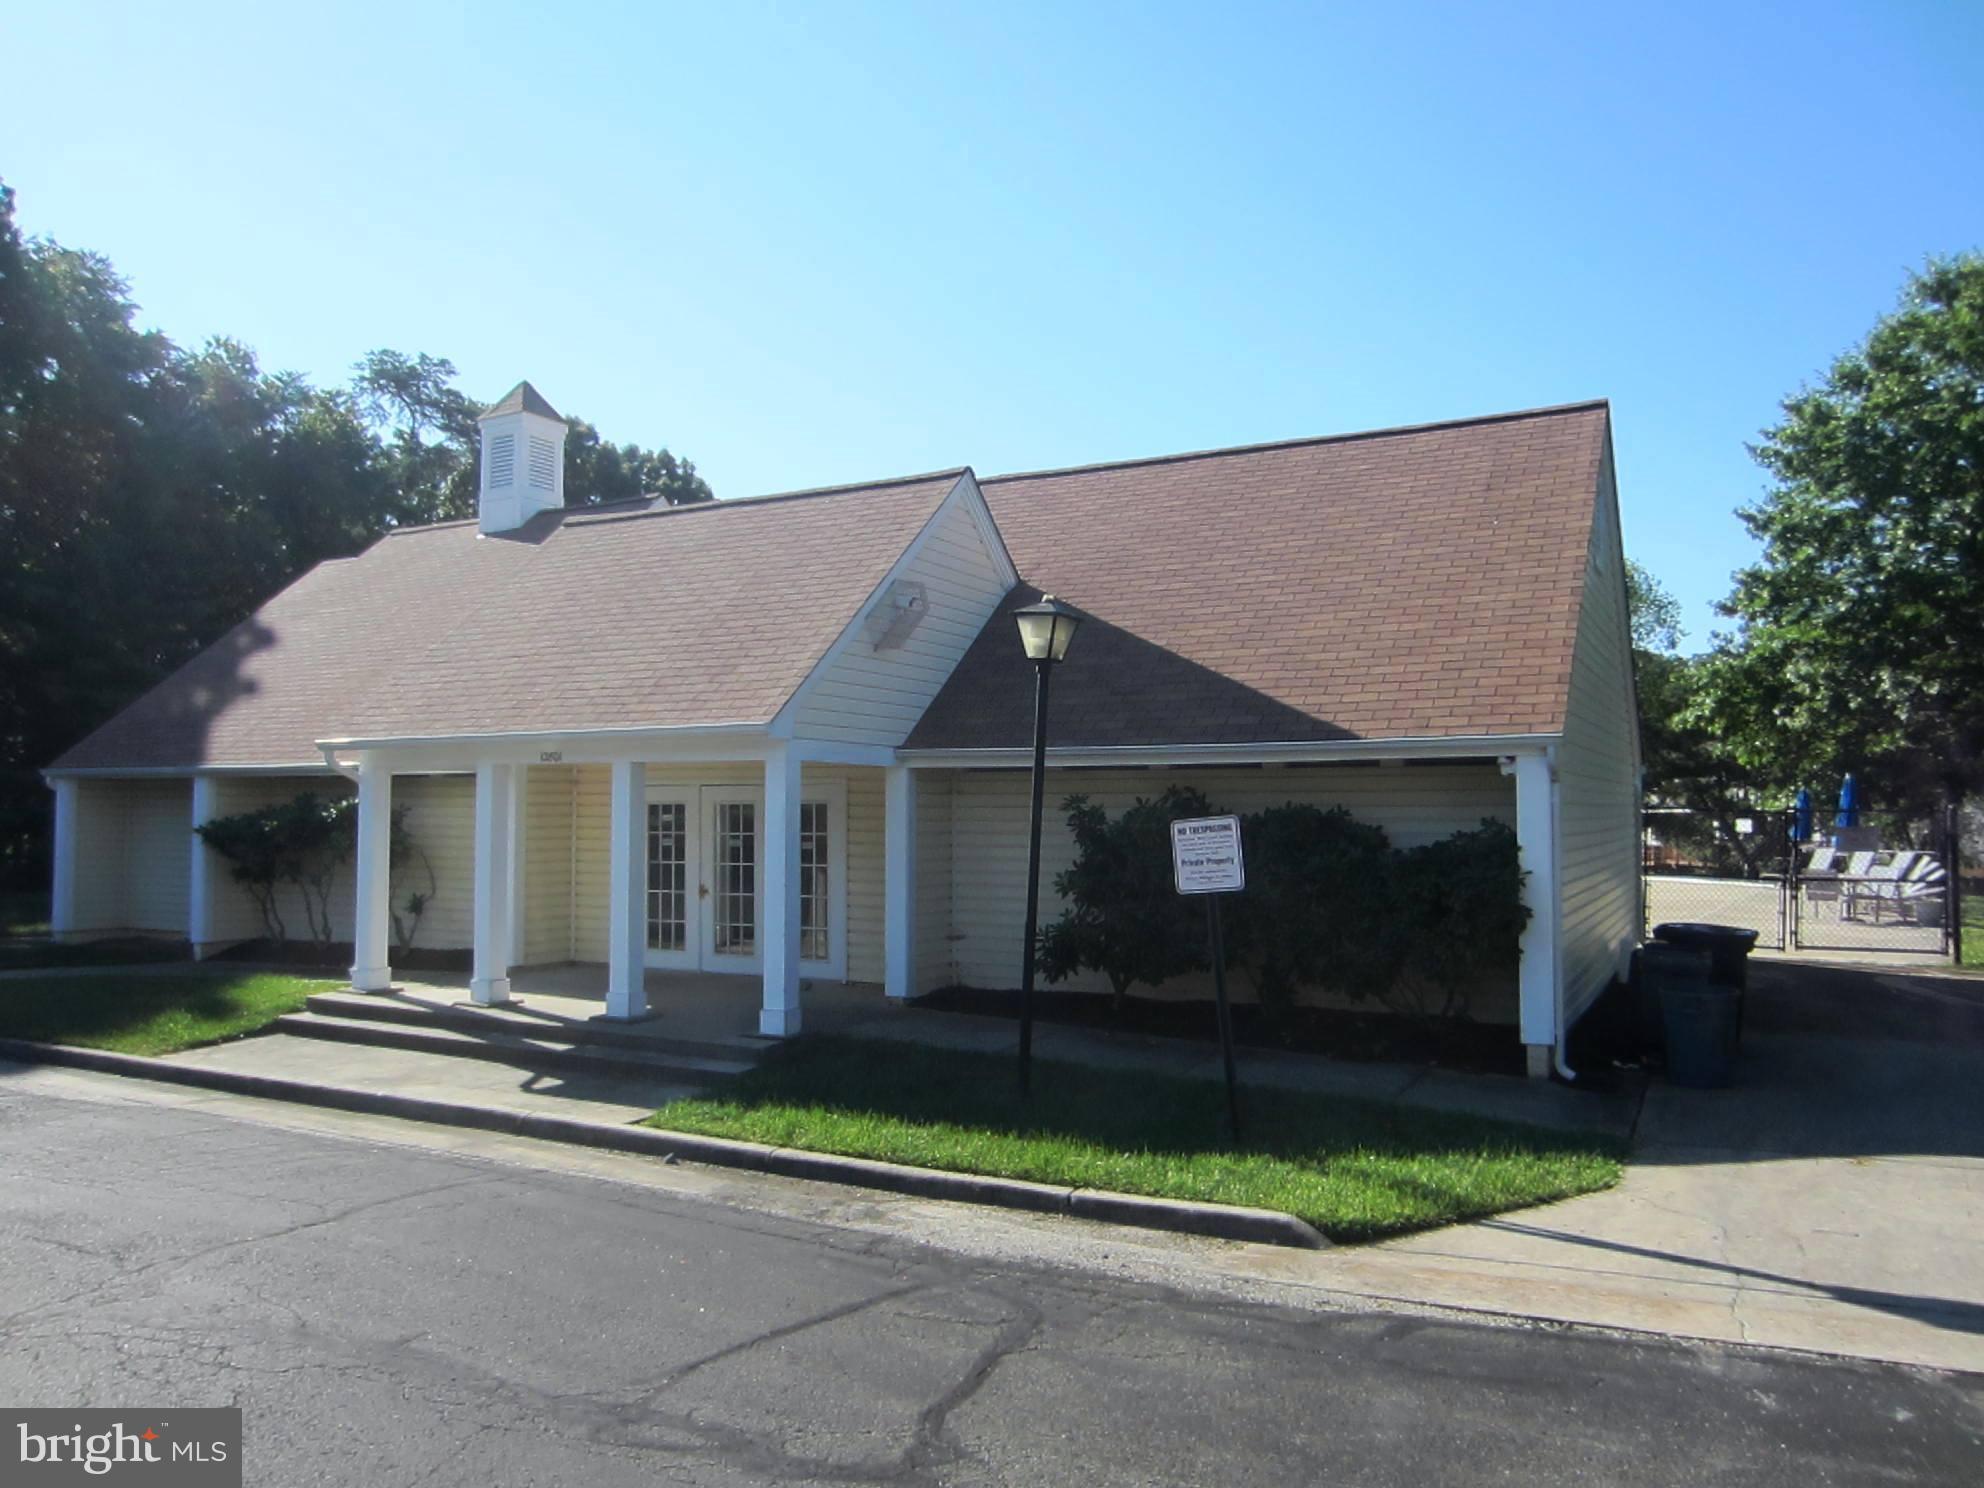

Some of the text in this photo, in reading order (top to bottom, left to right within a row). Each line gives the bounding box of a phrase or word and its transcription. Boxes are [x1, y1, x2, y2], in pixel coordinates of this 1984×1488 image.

[1177, 823, 1233, 836] NO TRESPASSING
[1181, 856, 1234, 867] Private Property
